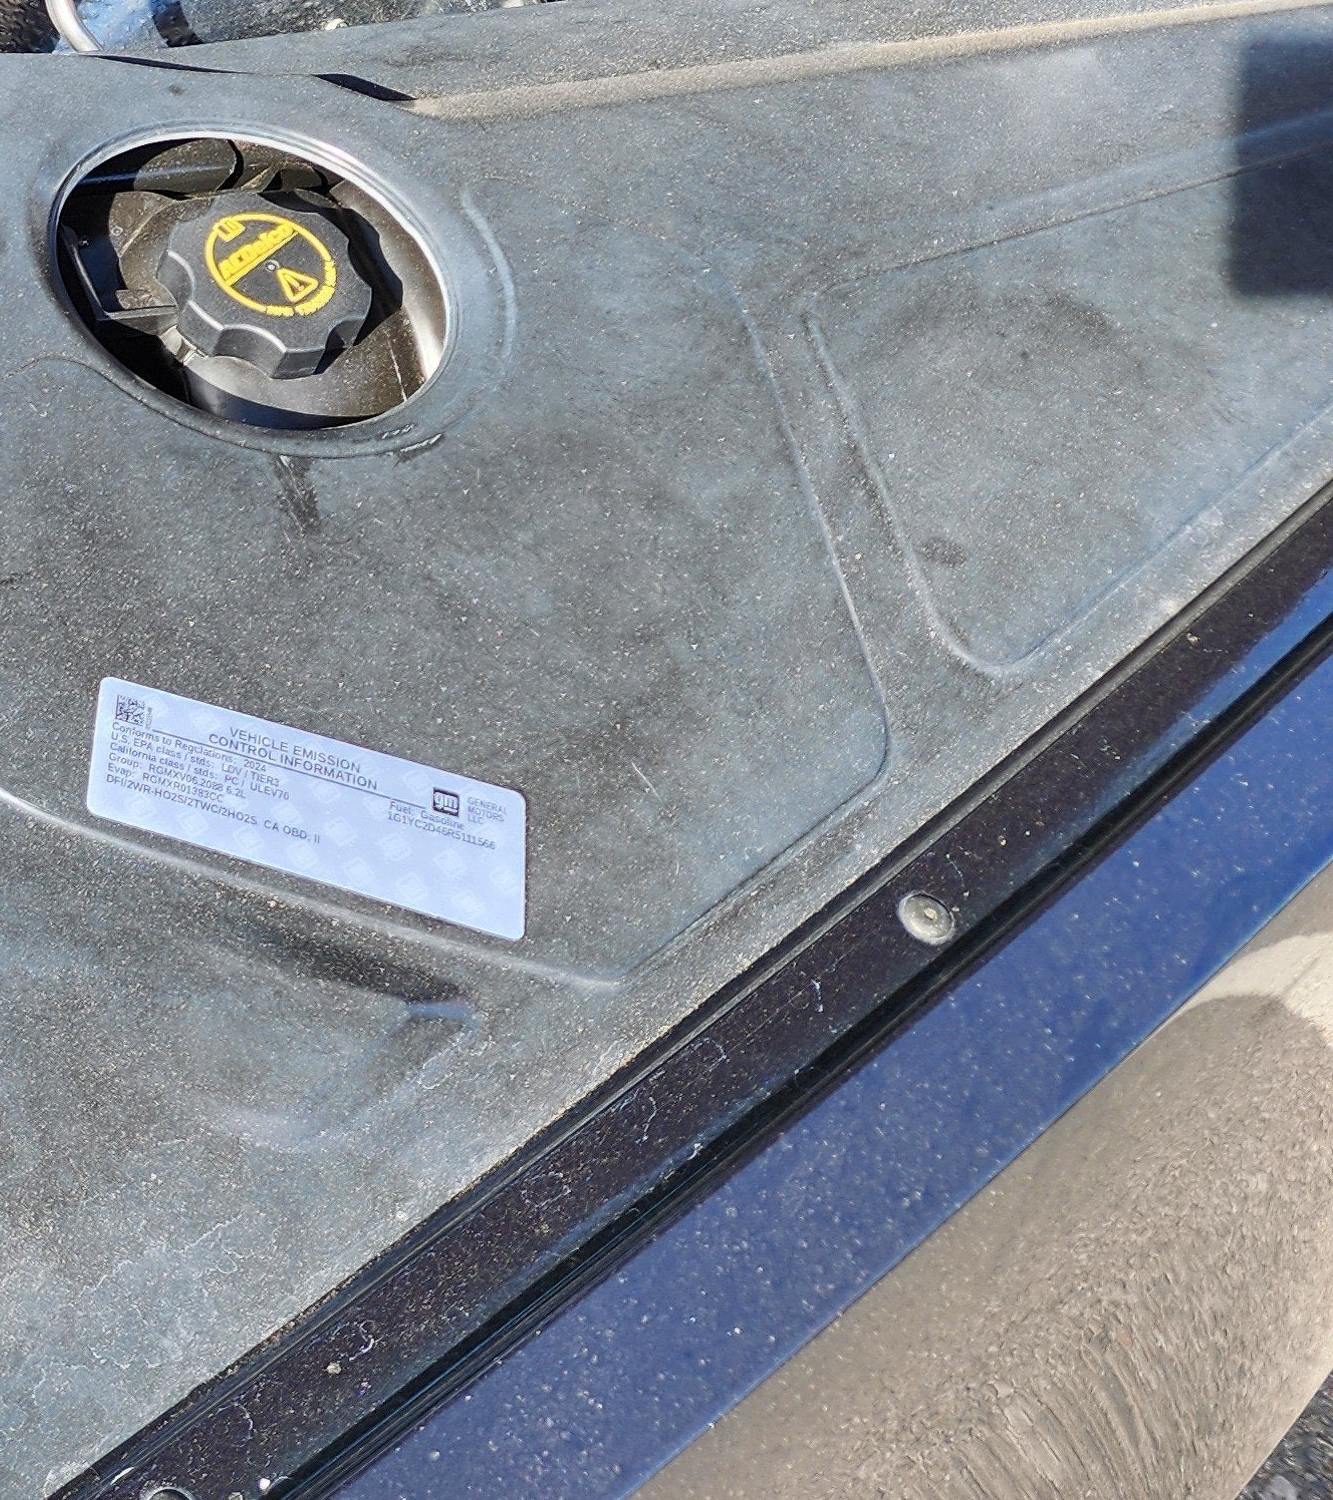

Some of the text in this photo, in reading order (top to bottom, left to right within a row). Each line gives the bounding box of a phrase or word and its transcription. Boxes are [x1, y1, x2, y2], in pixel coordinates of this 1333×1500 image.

[218, 222, 294, 281] ACDelco
[112, 721, 161, 743] Conforms
[162, 736, 171, 745] to
[243, 758, 266, 772] 2024
[229, 726, 360, 773] VEHICLE EMISSION
[109, 741, 156, 763] California
[159, 755, 184, 770] class
[224, 774, 238, 785] PC
[250, 781, 289, 801] ULEV70
[133, 738, 153, 751] EPA
[155, 744, 182, 759] class
[221, 762, 244, 777] LDV
[250, 771, 279, 787] TIER3
[208, 732, 377, 790] CONTROL INFORMATION
[225, 785, 247, 799] 6.2L
[433, 788, 458, 816] gm
[467, 796, 507, 814] GENERAL
[263, 818, 279, 831] CA
[420, 809, 464, 830] Gasoline
[467, 804, 504, 822] MOTORS
[467, 813, 483, 825] LLC
